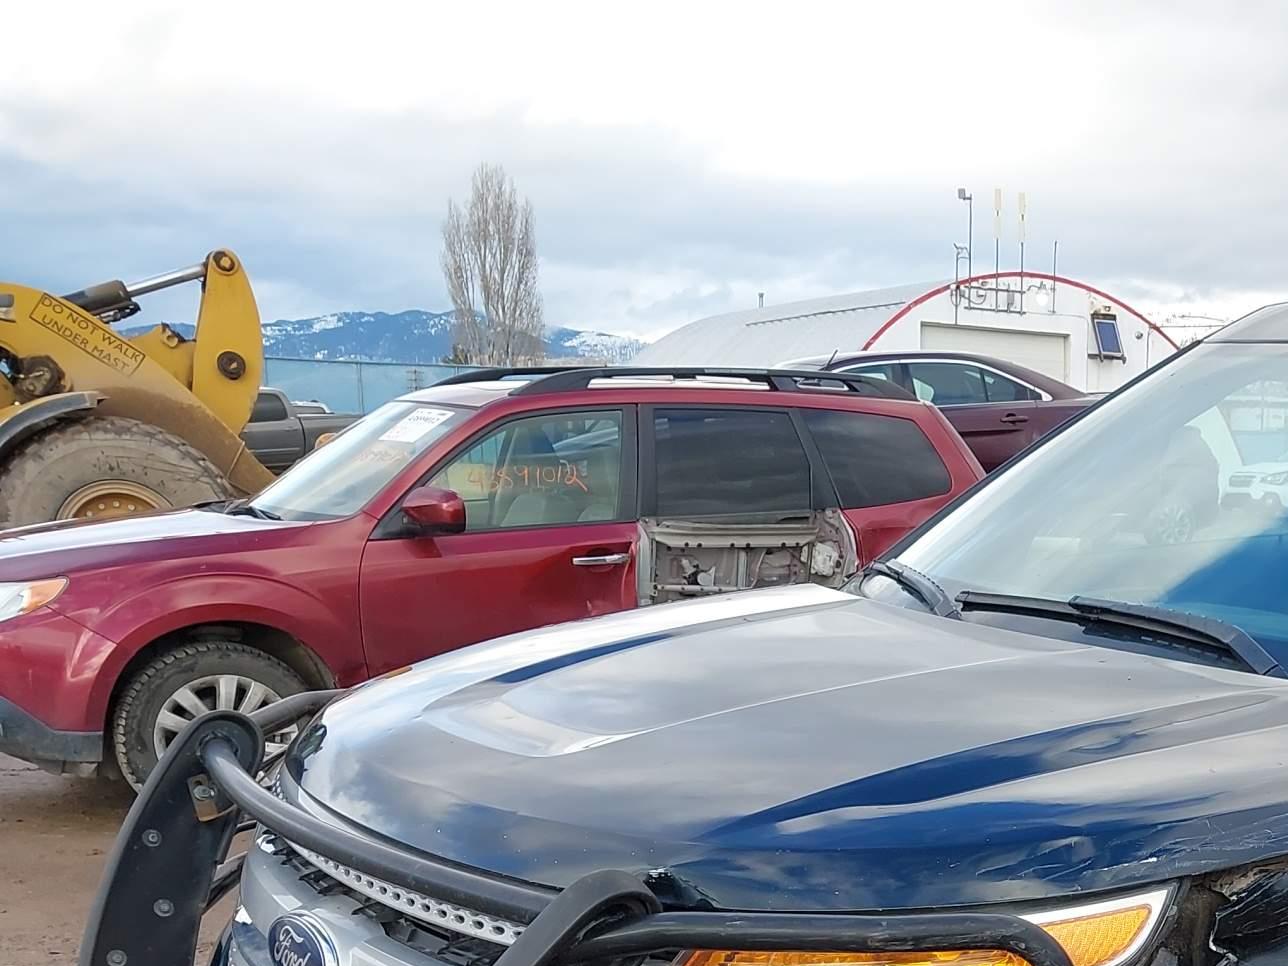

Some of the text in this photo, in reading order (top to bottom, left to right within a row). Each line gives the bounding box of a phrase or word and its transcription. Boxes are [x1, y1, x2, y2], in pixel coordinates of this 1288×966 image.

[41, 297, 141, 363] DO NOT WALK
[42, 314, 130, 371] UNDER MAST
